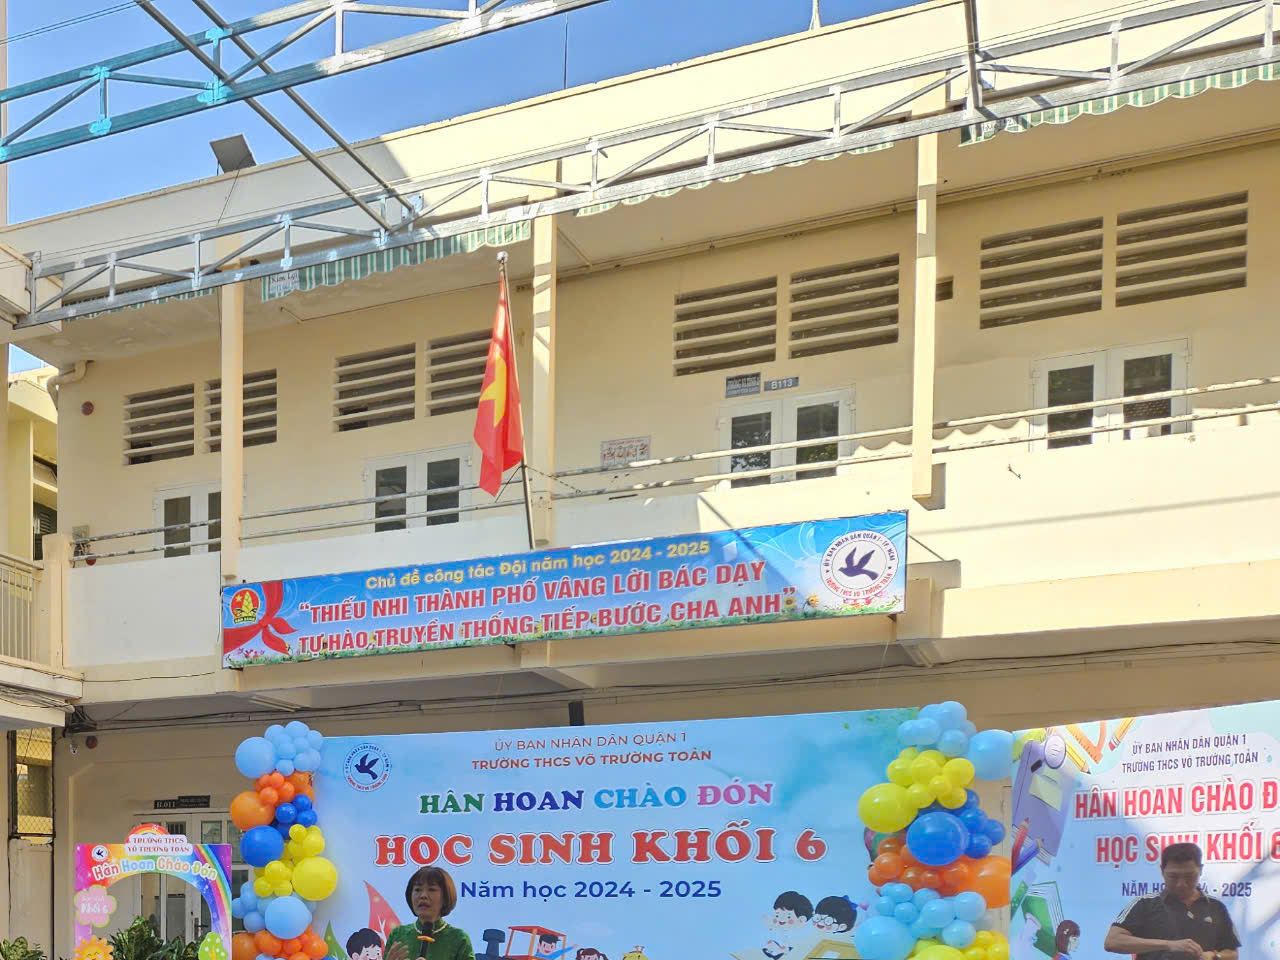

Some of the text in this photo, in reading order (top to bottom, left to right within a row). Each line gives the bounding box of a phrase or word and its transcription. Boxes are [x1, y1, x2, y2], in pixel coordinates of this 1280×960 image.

[366, 573, 396, 589] Chủ
[400, 568, 420, 586] đề
[424, 569, 464, 584] công
[469, 564, 495, 578] tác
[500, 560, 526, 576] Đội
[531, 556, 568, 572] năm
[573, 553, 605, 570] học
[610, 546, 652, 564] 2024
[667, 541, 710, 559] 2025
[372, 596, 408, 618] NHI
[415, 588, 486, 614] THÀNH
[492, 577, 539, 605] PHỐ
[543, 575, 606, 600] VÂNG
[613, 567, 650, 594] LỜI
[658, 564, 707, 589] BÁC
[716, 560, 766, 586] DẠY
[299, 634, 323, 658] TỰ
[328, 629, 368, 651] HÀO
[375, 618, 455, 648] TRUYỀN
[462, 611, 534, 639] THỐNG
[541, 606, 590, 632] TIẾP
[598, 600, 661, 627] BƯỚC
[670, 598, 719, 621] CHA
[495, 732, 686, 751] ỦY BAN NHÂN DÂN QUẬN 1
[1145, 741, 1163, 754] BAN
[1165, 737, 1190, 752] NHÂN
[1192, 735, 1211, 749] DÂN
[1214, 733, 1239, 749] QUẬN
[1242, 734, 1247, 745] 1
[472, 756, 530, 770] TRƯỜNG
[534, 756, 571, 768] THCS
[575, 753, 596, 766] VÕ
[600, 750, 664, 764] TRƯỜNG
[1122, 759, 1155, 774] TRƯỜNG
[1157, 757, 1179, 771] THCS
[1195, 752, 1231, 768] TRƯỜNG
[419, 778, 773, 814] HÂN HOAN CHÀO ĐÓN
[1075, 786, 1117, 819] HÂN
[1124, 787, 1184, 817] HOAN
[1191, 776, 1254, 813] CHÀO
[488, 832, 615, 866] SINH
[631, 820, 777, 864] KHỐI
[795, 829, 827, 864] 6
[1096, 834, 1138, 869] HỌC
[1206, 820, 1262, 861] KHỐI
[93, 857, 218, 881] Hân Hoan Chào Đón
[461, 880, 515, 898] Năm
[523, 880, 567, 902] học
[574, 880, 635, 898] 2024
[659, 880, 722, 898] 2025
[1122, 880, 1148, 897] NĂM
[1222, 881, 1252, 897] 2025
